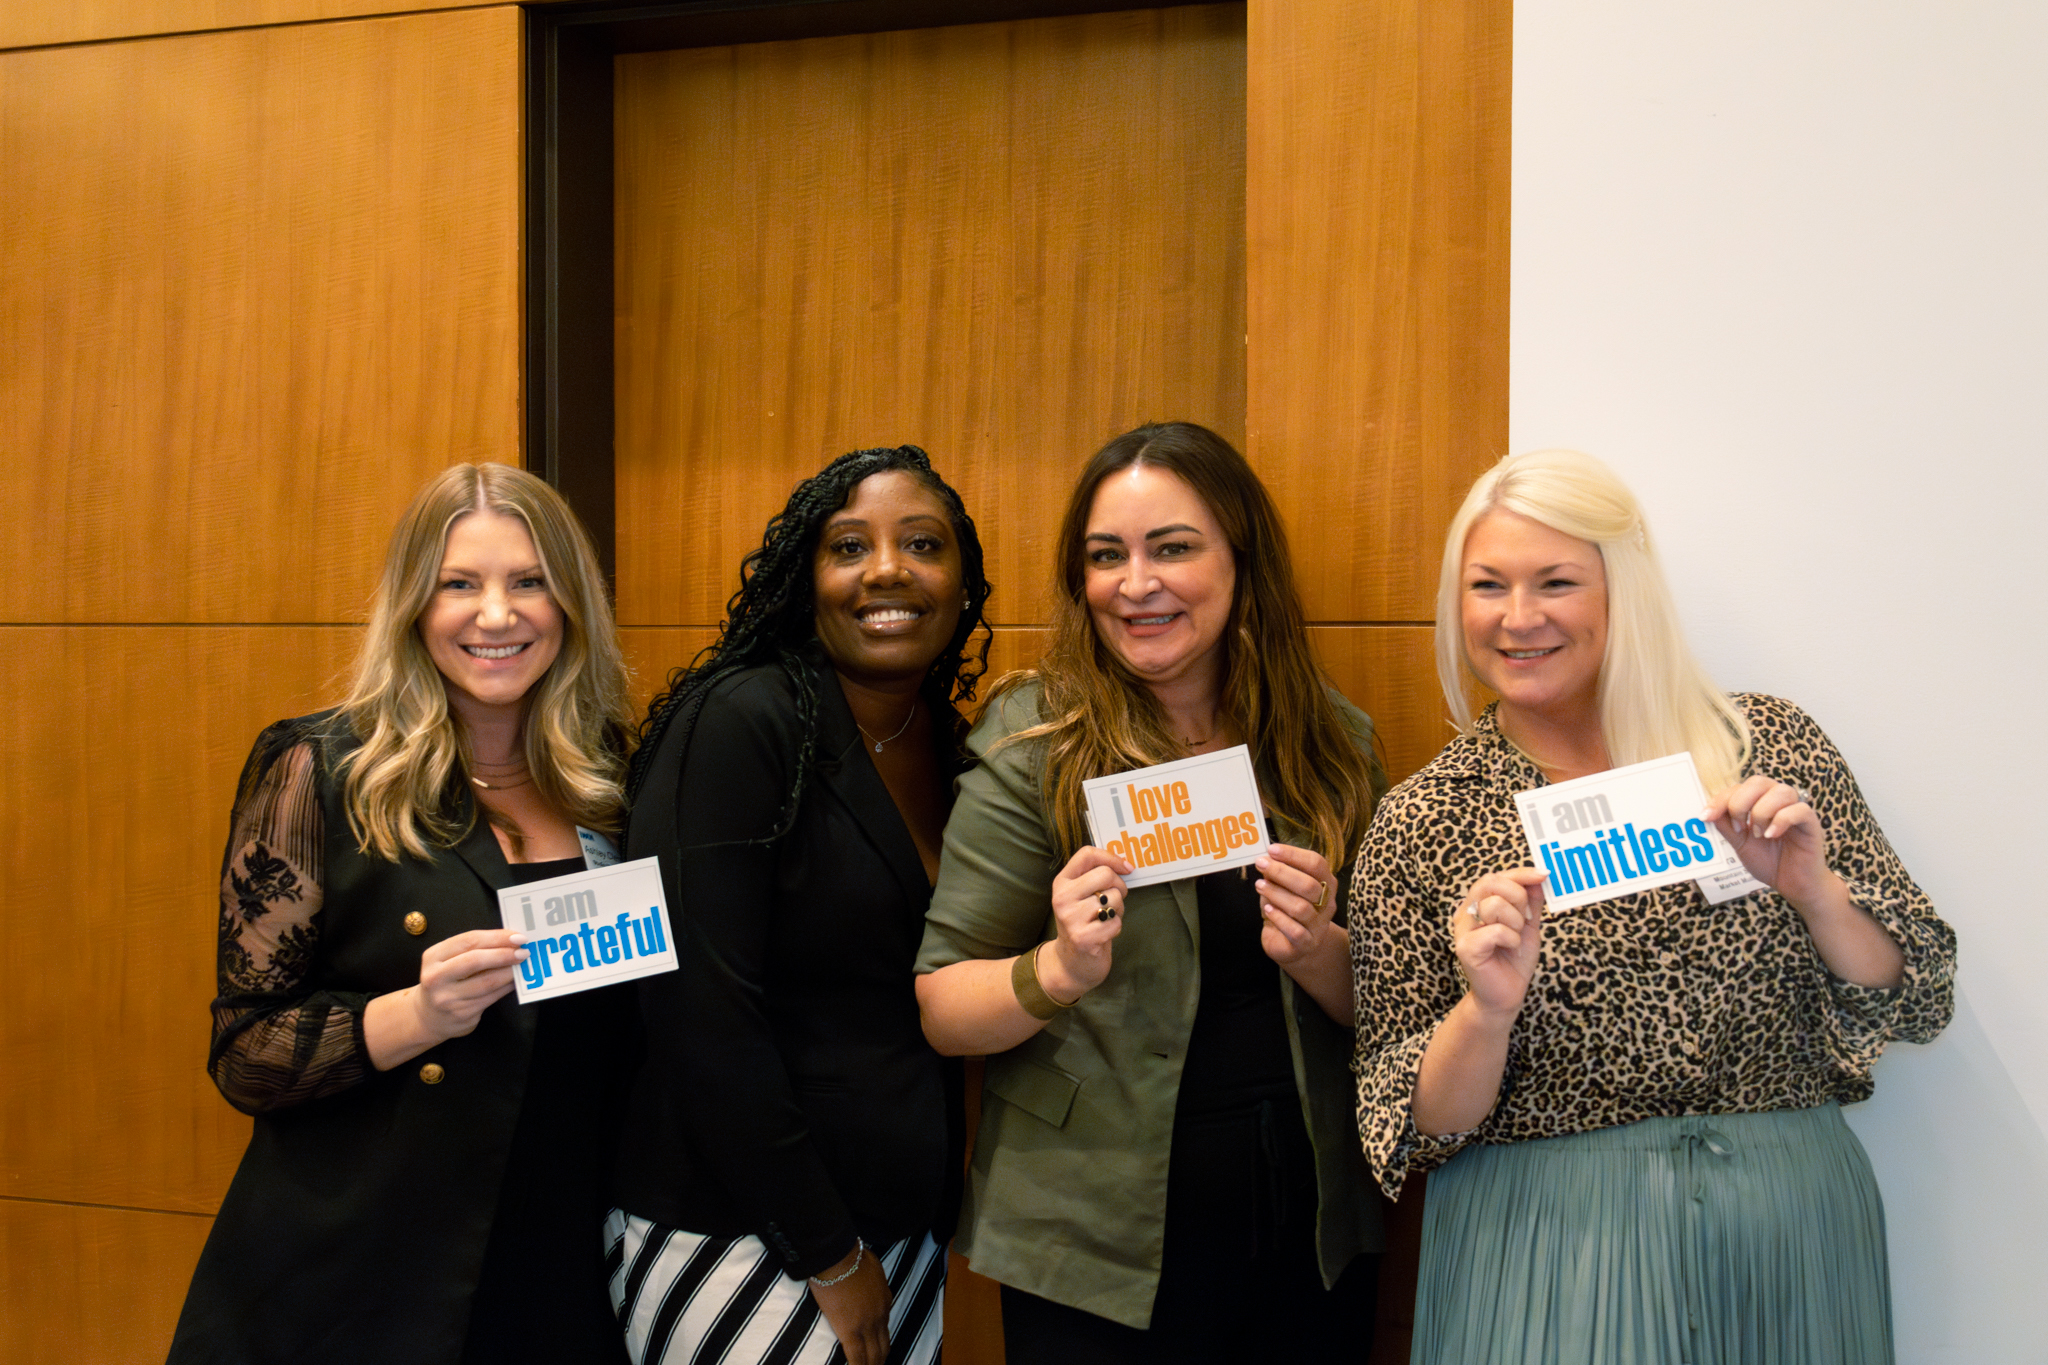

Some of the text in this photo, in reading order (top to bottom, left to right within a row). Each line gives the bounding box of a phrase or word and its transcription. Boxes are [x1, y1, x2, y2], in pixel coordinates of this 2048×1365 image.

[1110, 781, 1192, 828] i love
[1526, 793, 1614, 840] i am
[1106, 811, 1260, 869] challenges
[1539, 818, 1715, 897] limitless
[520, 889, 599, 932] i am
[520, 905, 668, 990] grateful
